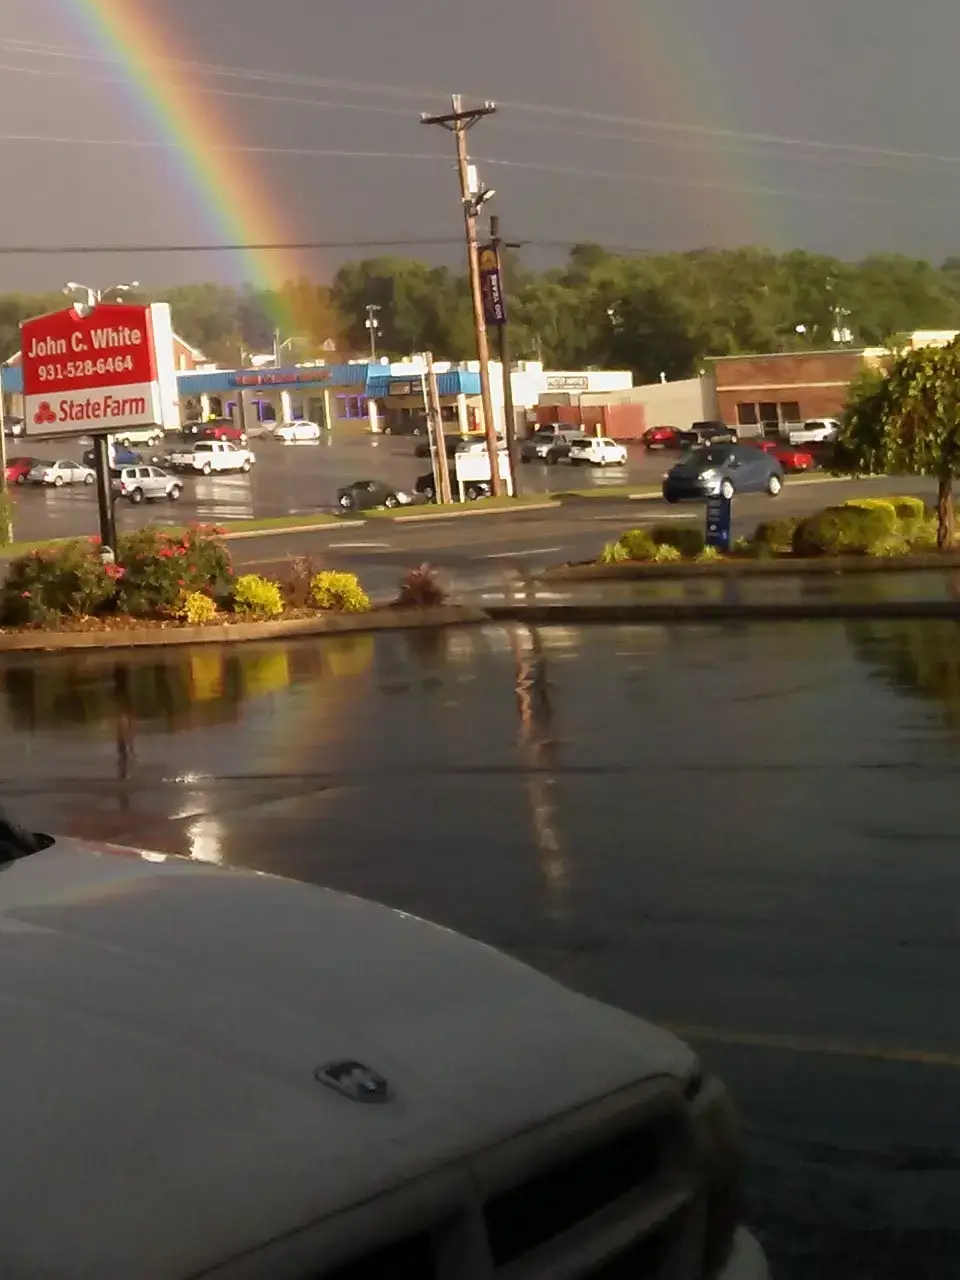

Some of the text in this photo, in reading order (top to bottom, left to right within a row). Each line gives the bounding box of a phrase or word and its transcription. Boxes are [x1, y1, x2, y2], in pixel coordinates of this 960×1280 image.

[27, 325, 141, 358] John C. White
[37, 355, 133, 381] 931-528-6464
[58, 395, 145, 422] State Farm
